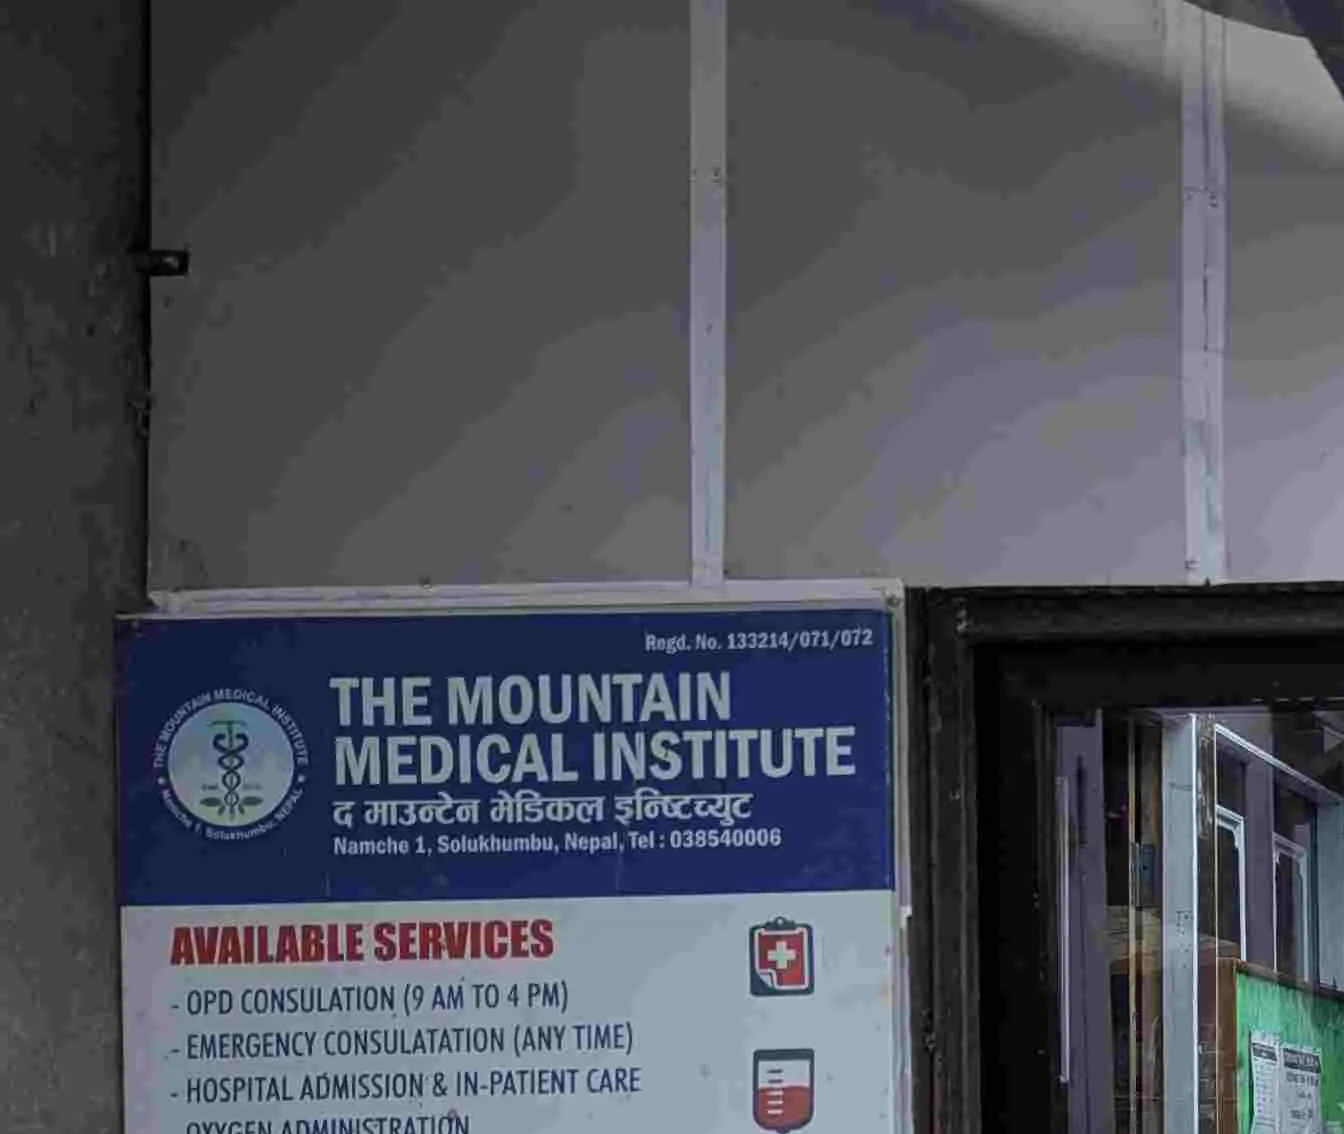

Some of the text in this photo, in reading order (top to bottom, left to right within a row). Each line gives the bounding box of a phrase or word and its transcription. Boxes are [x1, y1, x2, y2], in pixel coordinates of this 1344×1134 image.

[645, 633, 691, 654] Regd.
[696, 634, 722, 650] No.
[329, 671, 731, 726] THE MOUNTAIN
[153, 744, 167, 769] THE
[213, 688, 271, 711] MEDICAL
[271, 704, 309, 766] INSTITUTE
[335, 726, 856, 785] MEDICAL INSTITUTE
[332, 801, 355, 828] द
[333, 836, 409, 855] Namche
[415, 836, 432, 857] 1,
[437, 833, 559, 855] Solukhumbu,
[564, 831, 624, 855] Nepal,
[628, 831, 654, 848] Tel
[670, 828, 782, 848] 038540006
[170, 918, 554, 966] AVAILABLE SERVICES
[187, 980, 568, 1017] OPD CONSULATION (9 AM TO 4 PM)
[187, 1021, 633, 1060] EMERGENCY CONSULATATION (ANY TIME)
[187, 1067, 642, 1105] HOSPITAL ADMISSION & IN-PATIENT CARE
